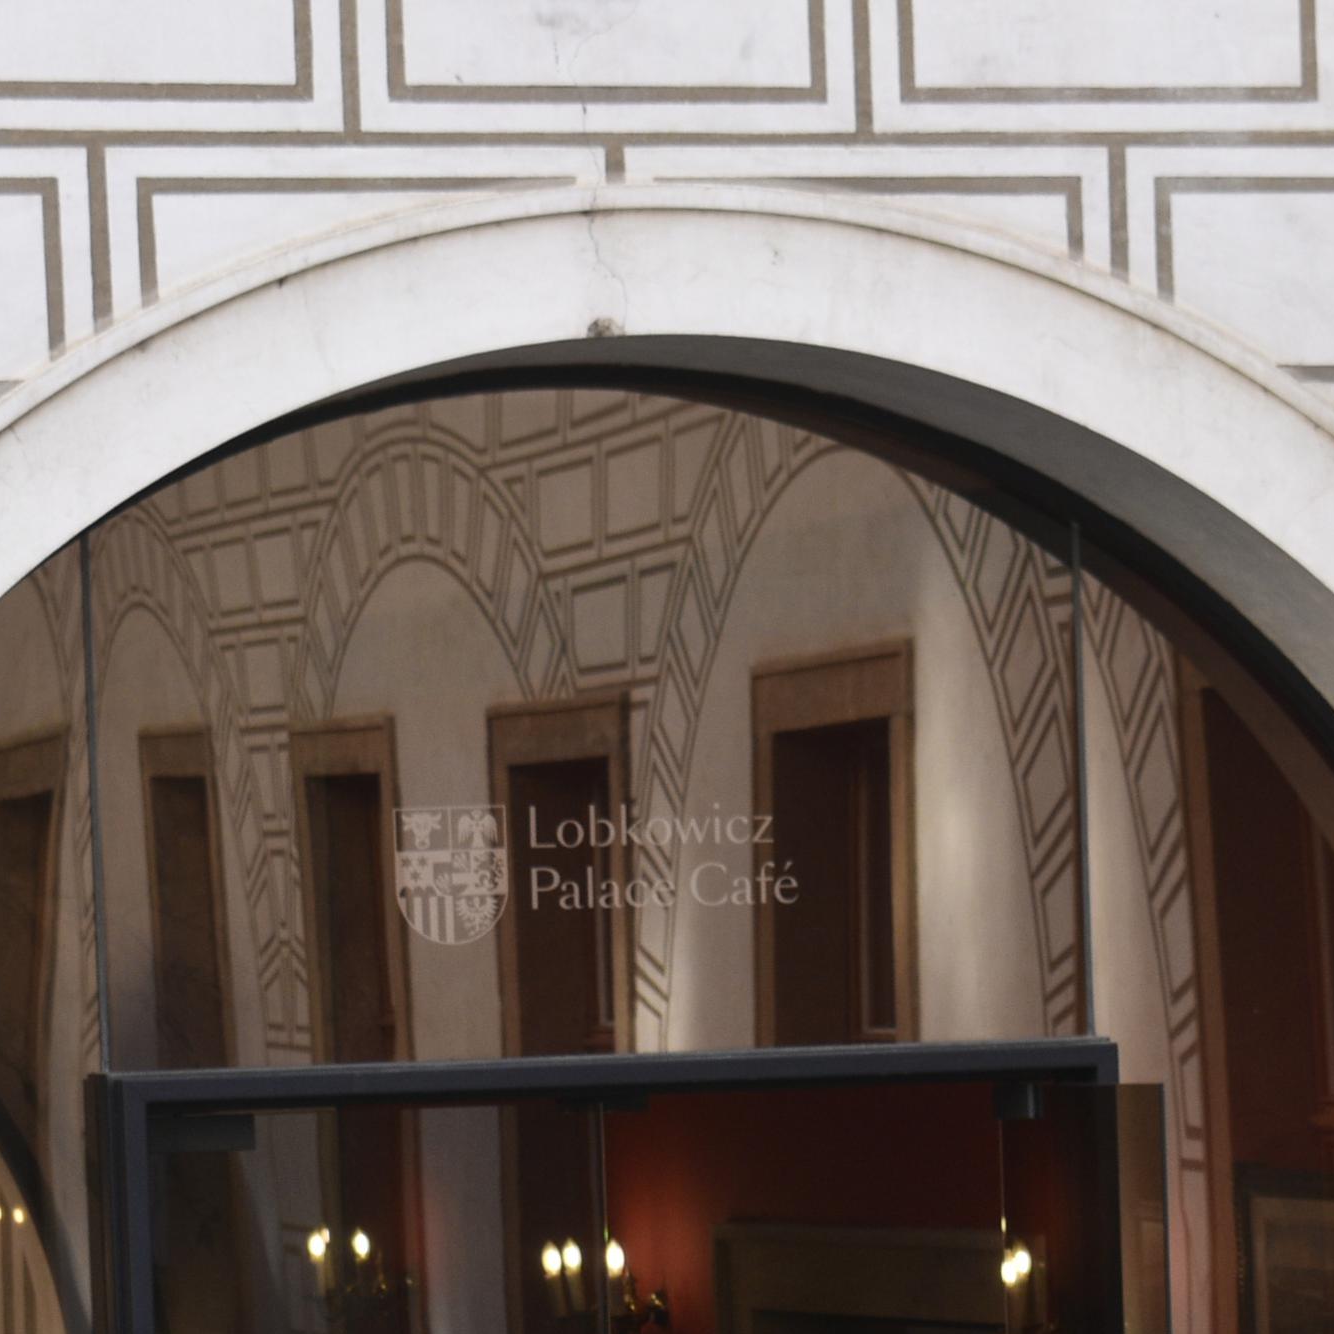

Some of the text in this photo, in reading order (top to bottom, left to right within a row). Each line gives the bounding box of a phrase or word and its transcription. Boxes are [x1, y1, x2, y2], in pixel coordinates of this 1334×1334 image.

[528, 803, 775, 849] Lobkowicz
[529, 860, 799, 911] Palace Café
